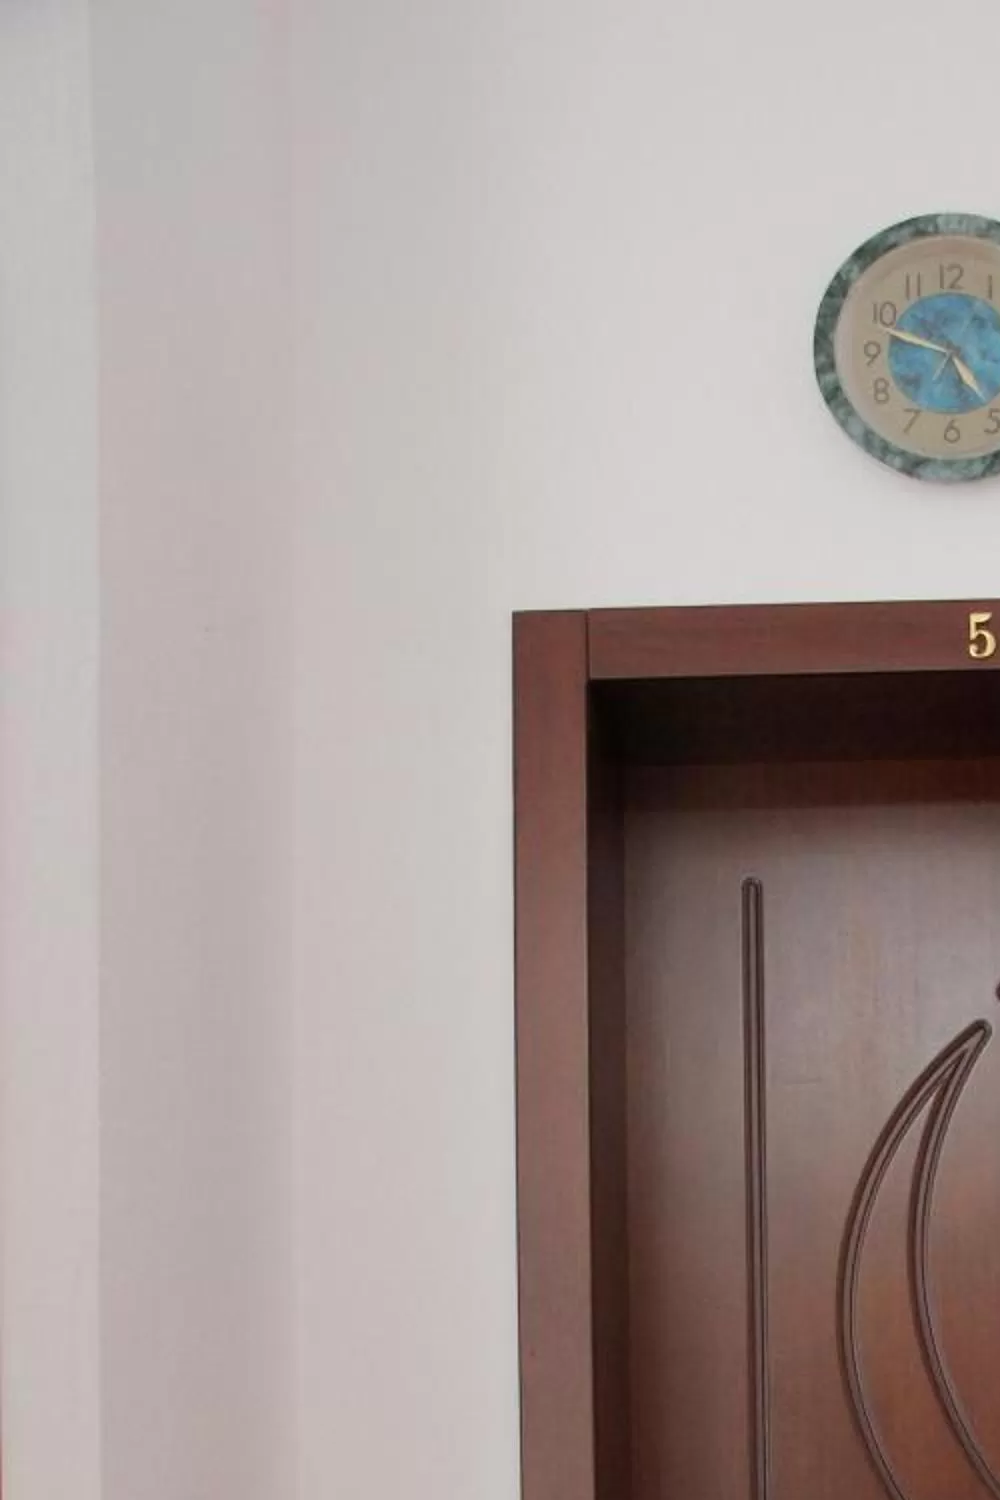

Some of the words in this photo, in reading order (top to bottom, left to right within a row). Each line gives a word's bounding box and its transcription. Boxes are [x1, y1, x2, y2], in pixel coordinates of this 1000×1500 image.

[905, 272, 921, 298] 11
[939, 264, 964, 290] 12
[987, 274, 993, 299] 1
[872, 302, 897, 327] 10
[863, 341, 881, 366] 9
[873, 377, 890, 404] 8
[903, 409, 921, 434] 7
[943, 420, 961, 444] 6
[984, 408, 1000, 435] 5
[969, 611, 997, 658] 5
